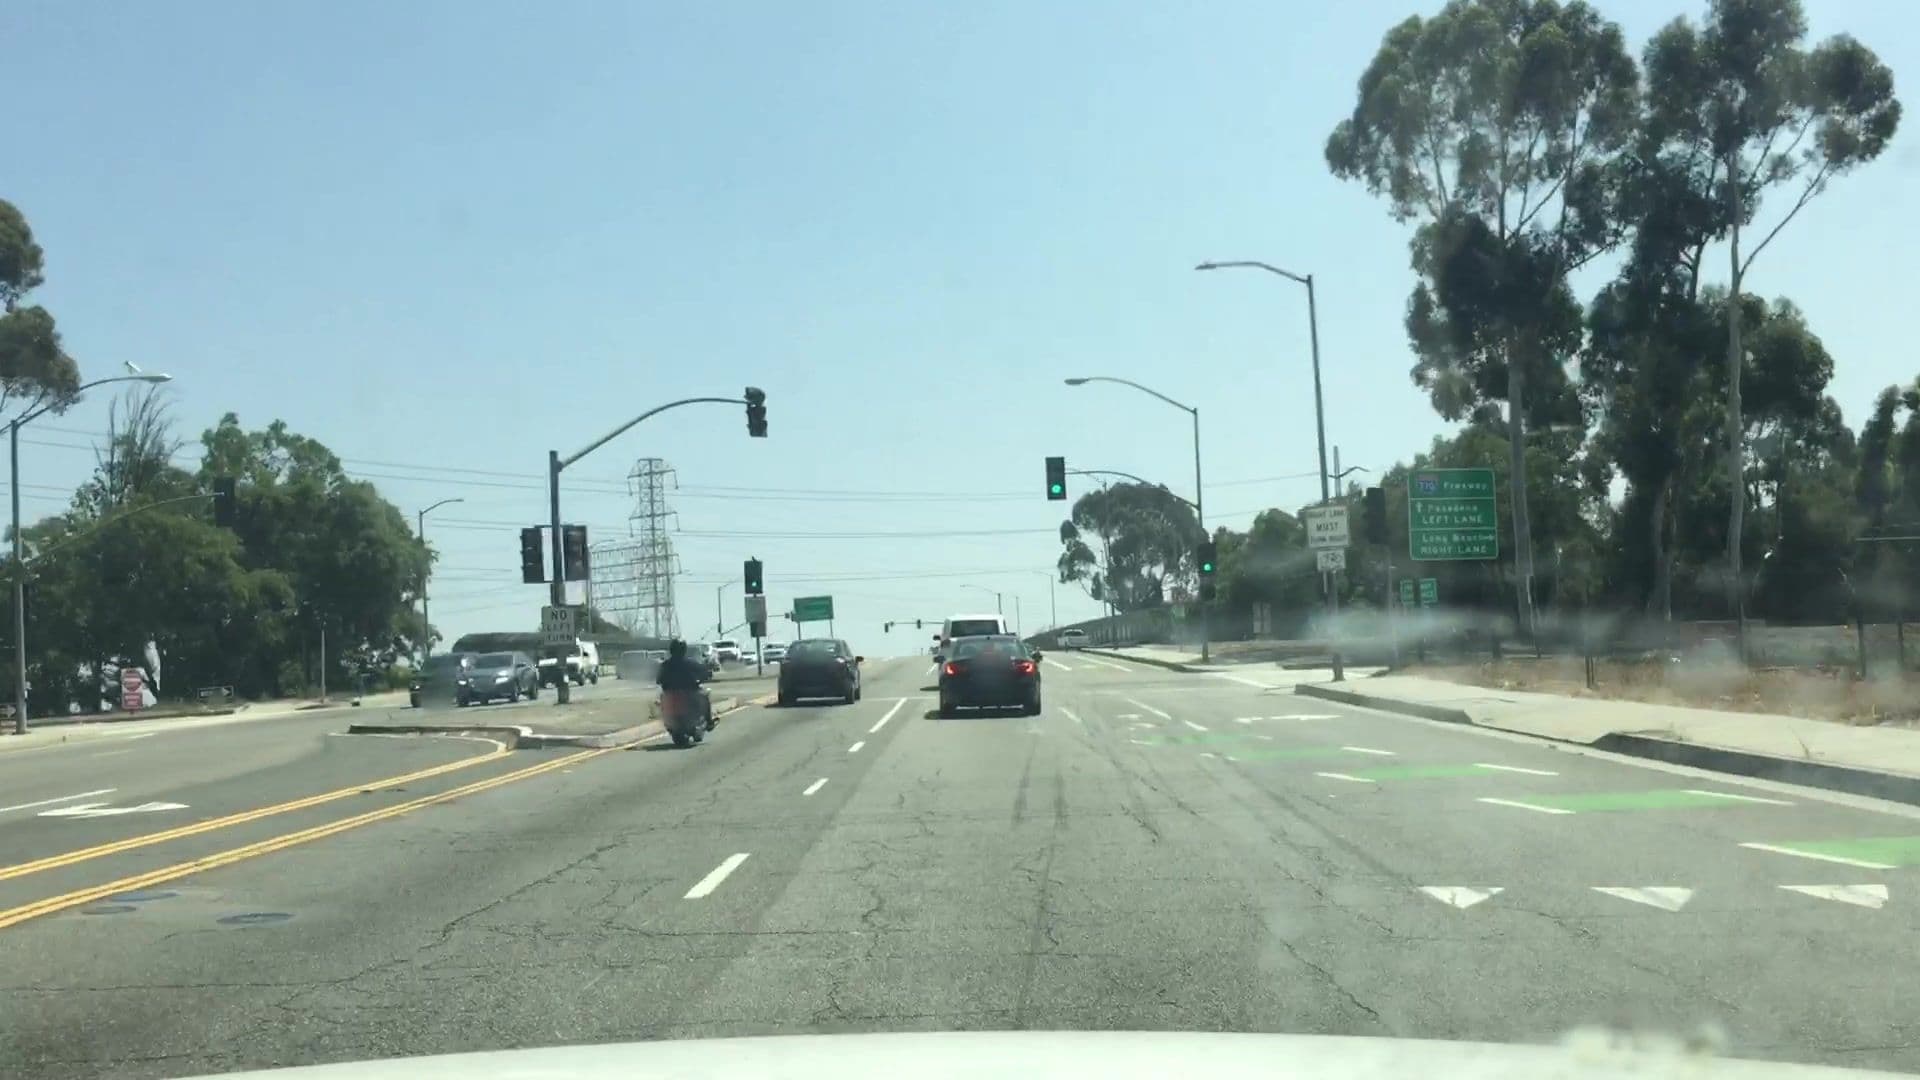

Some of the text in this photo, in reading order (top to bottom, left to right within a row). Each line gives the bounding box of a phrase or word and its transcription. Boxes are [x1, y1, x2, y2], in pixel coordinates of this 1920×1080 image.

[1427, 503, 1478, 513] Pasadena
[1422, 514, 1482, 525] LEFT LANE
[1316, 522, 1338, 531] MUST
[1421, 544, 1487, 555] RIGHT LANE
[551, 609, 567, 620] NO
